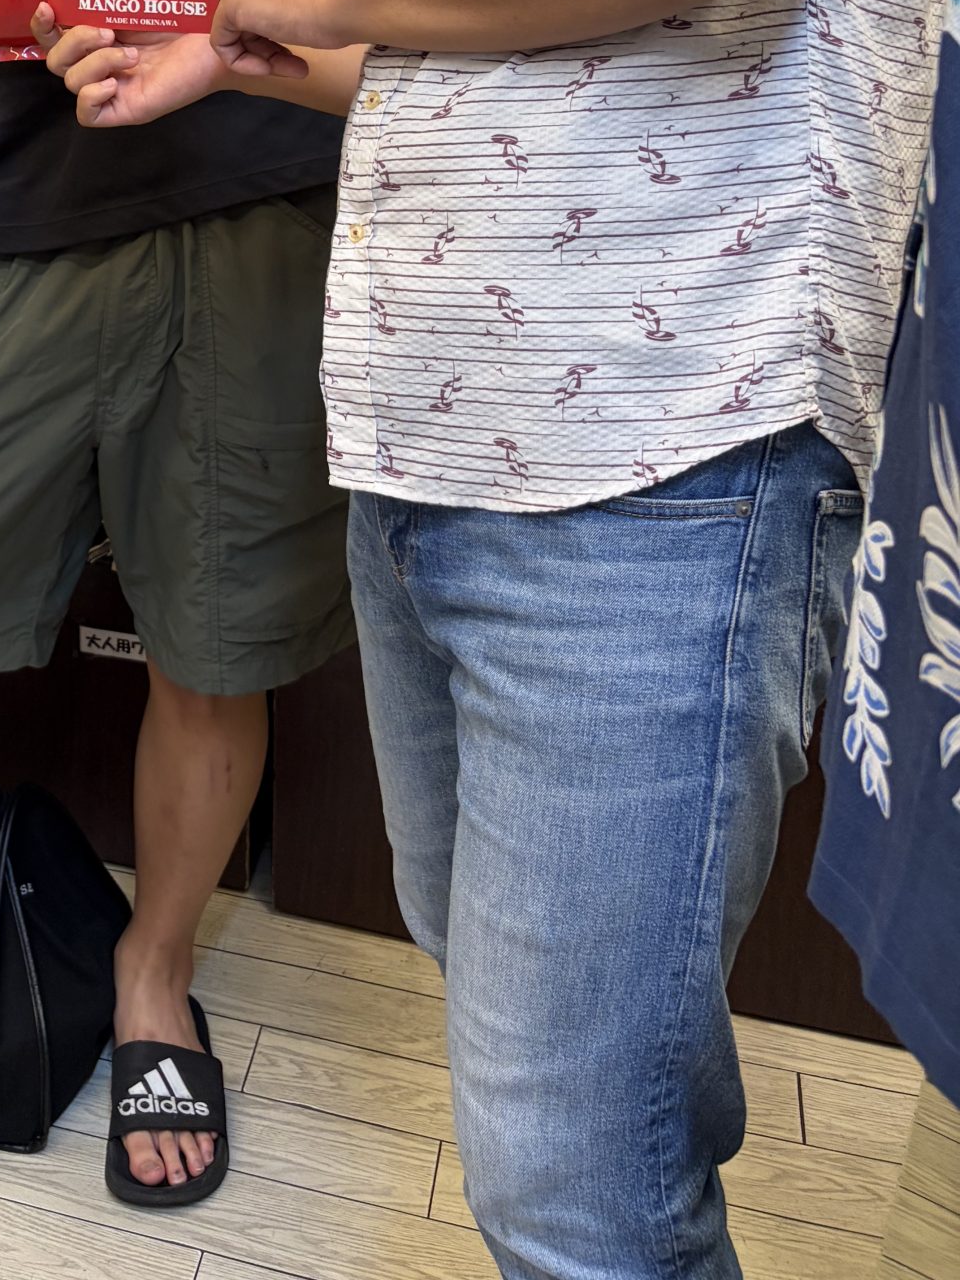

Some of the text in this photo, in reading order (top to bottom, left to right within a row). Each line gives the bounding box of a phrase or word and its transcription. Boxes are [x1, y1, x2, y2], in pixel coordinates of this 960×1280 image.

[143, 0, 208, 17] HOUSE
[105, 16, 179, 28] MADE IN OKINAWA
[117, 1093, 211, 1118] adidas
